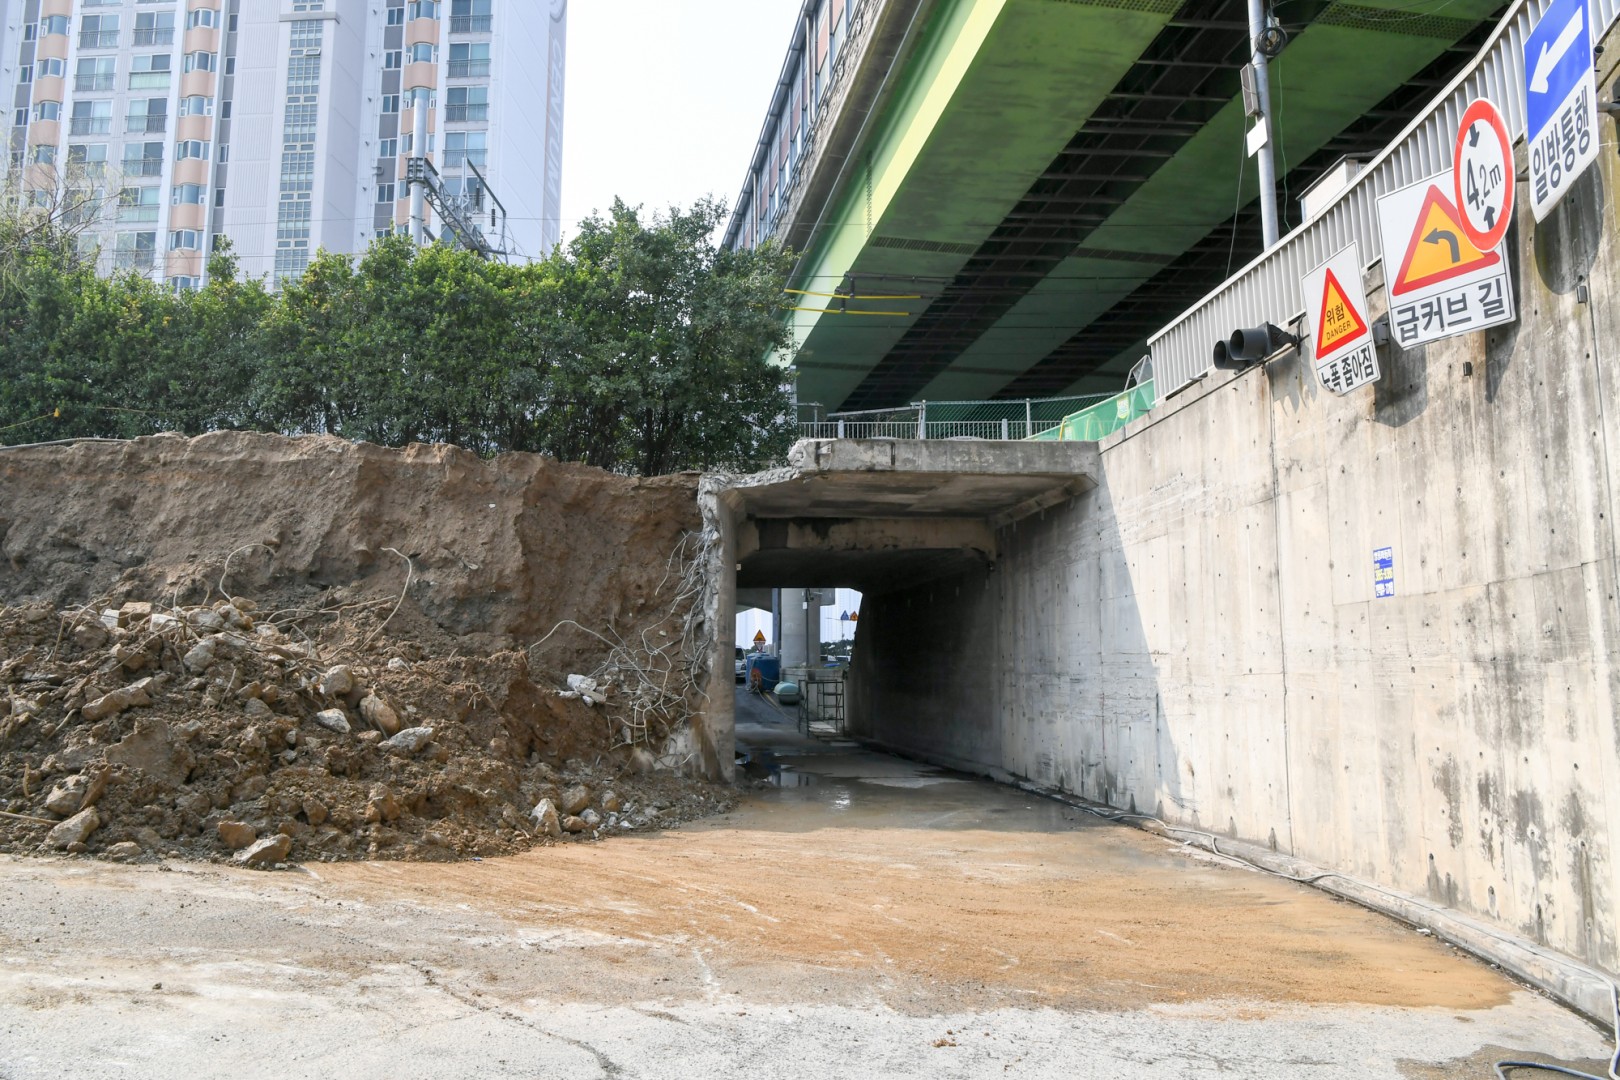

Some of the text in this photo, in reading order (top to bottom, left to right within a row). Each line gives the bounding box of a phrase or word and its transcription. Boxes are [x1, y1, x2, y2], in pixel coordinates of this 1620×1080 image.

[547, 38, 563, 199] CENTUM
[1533, 85, 1590, 205] 일방통행
[1467, 158, 1502, 211] 4.2m
[1326, 302, 1345, 326] 위험
[1326, 320, 1352, 340] DANGER
[1397, 278, 1506, 342] 급커브 길
